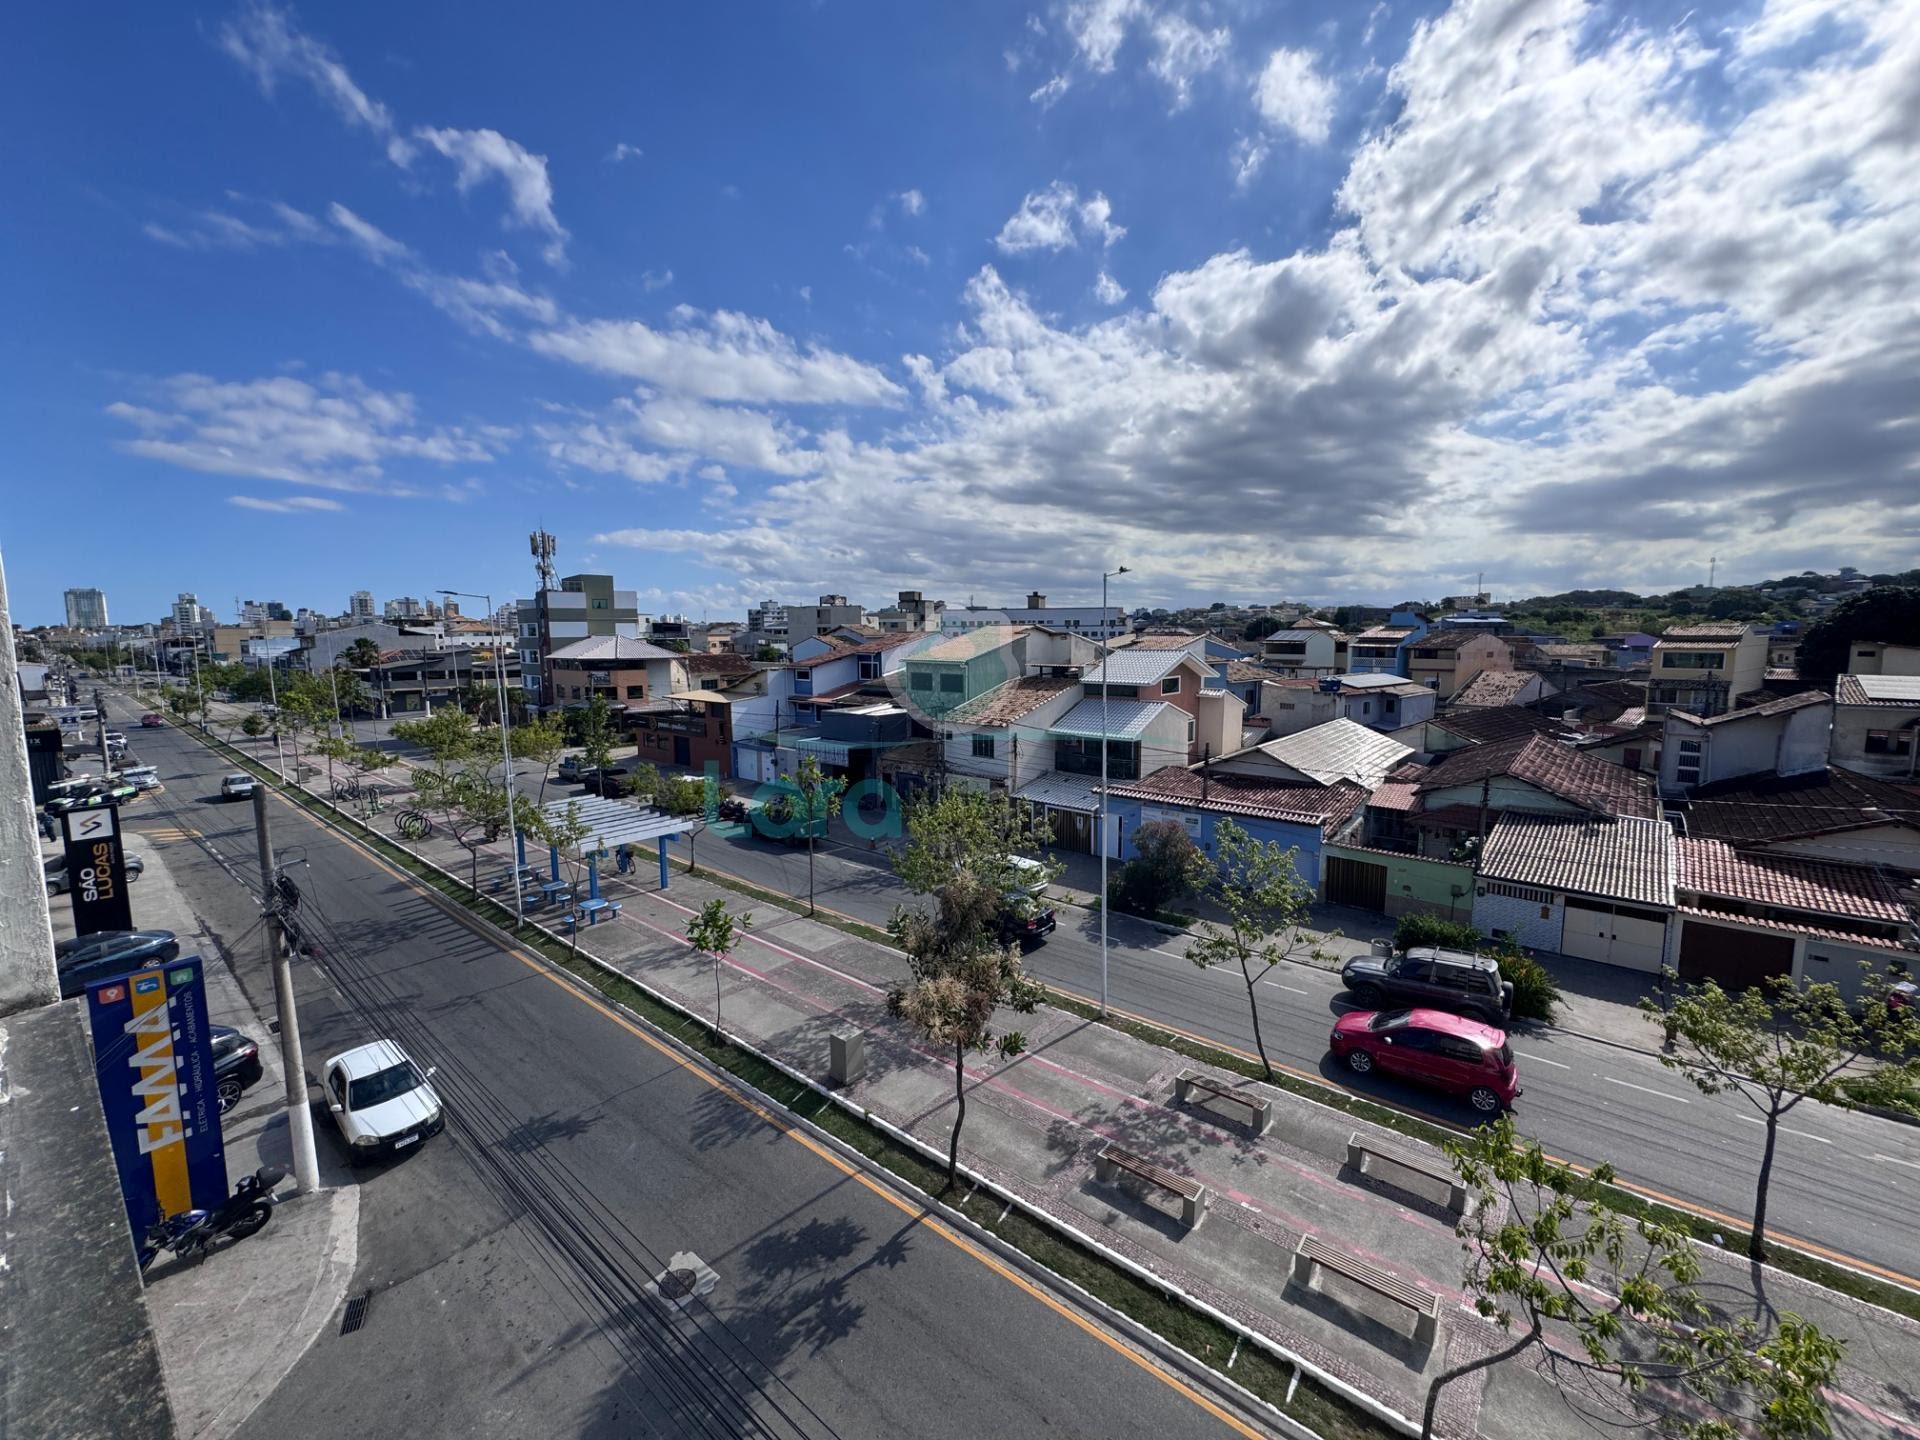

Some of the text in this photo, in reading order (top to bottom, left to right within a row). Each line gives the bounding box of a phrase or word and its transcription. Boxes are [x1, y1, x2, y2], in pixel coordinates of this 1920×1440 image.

[92, 842, 114, 900] LUCAS
[183, 990, 198, 1043] ACABAMENTOS
[123, 996, 193, 1156] FAMA
